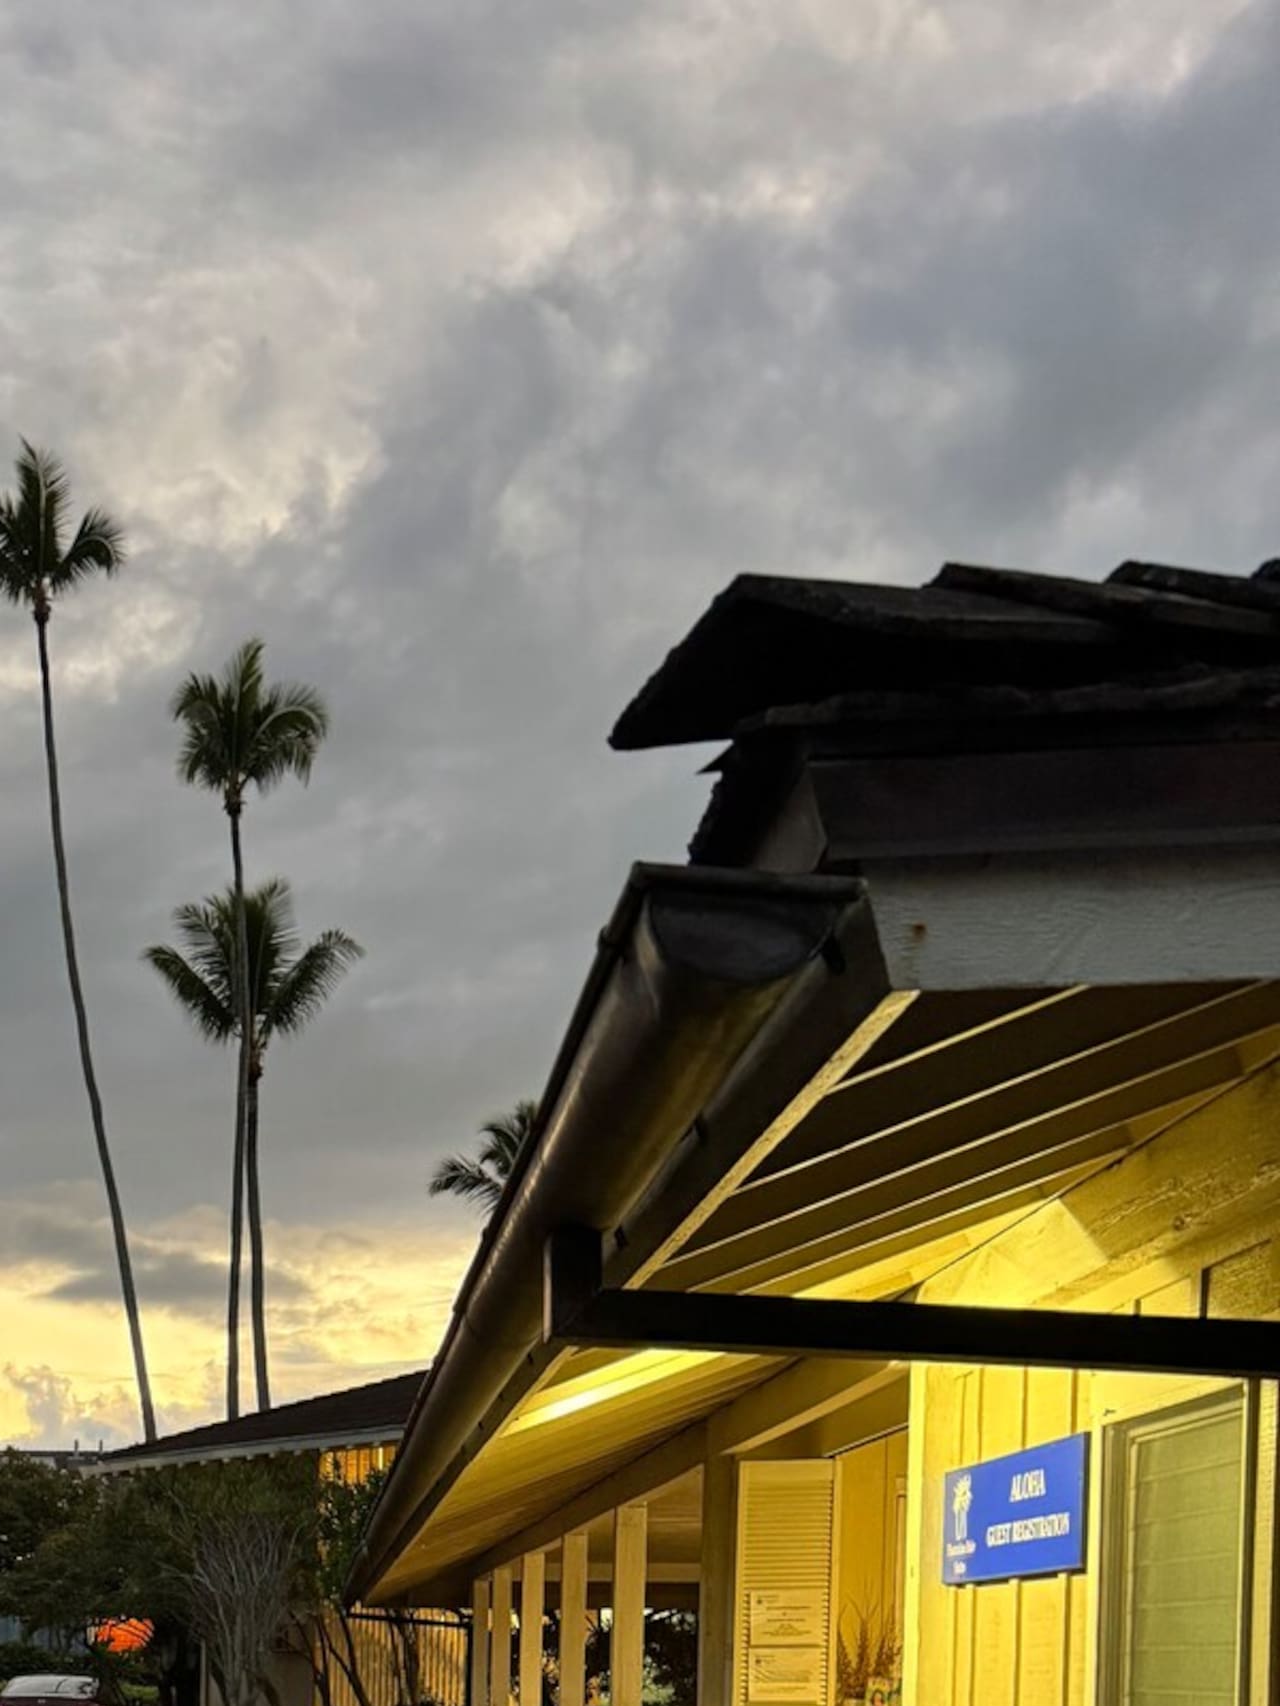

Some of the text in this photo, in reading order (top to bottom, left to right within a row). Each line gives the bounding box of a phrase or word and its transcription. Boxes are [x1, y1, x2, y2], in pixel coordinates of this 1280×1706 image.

[1009, 1468, 1047, 1503] ALOHA
[986, 1511, 1070, 1548] GUEST REGISTRATION
